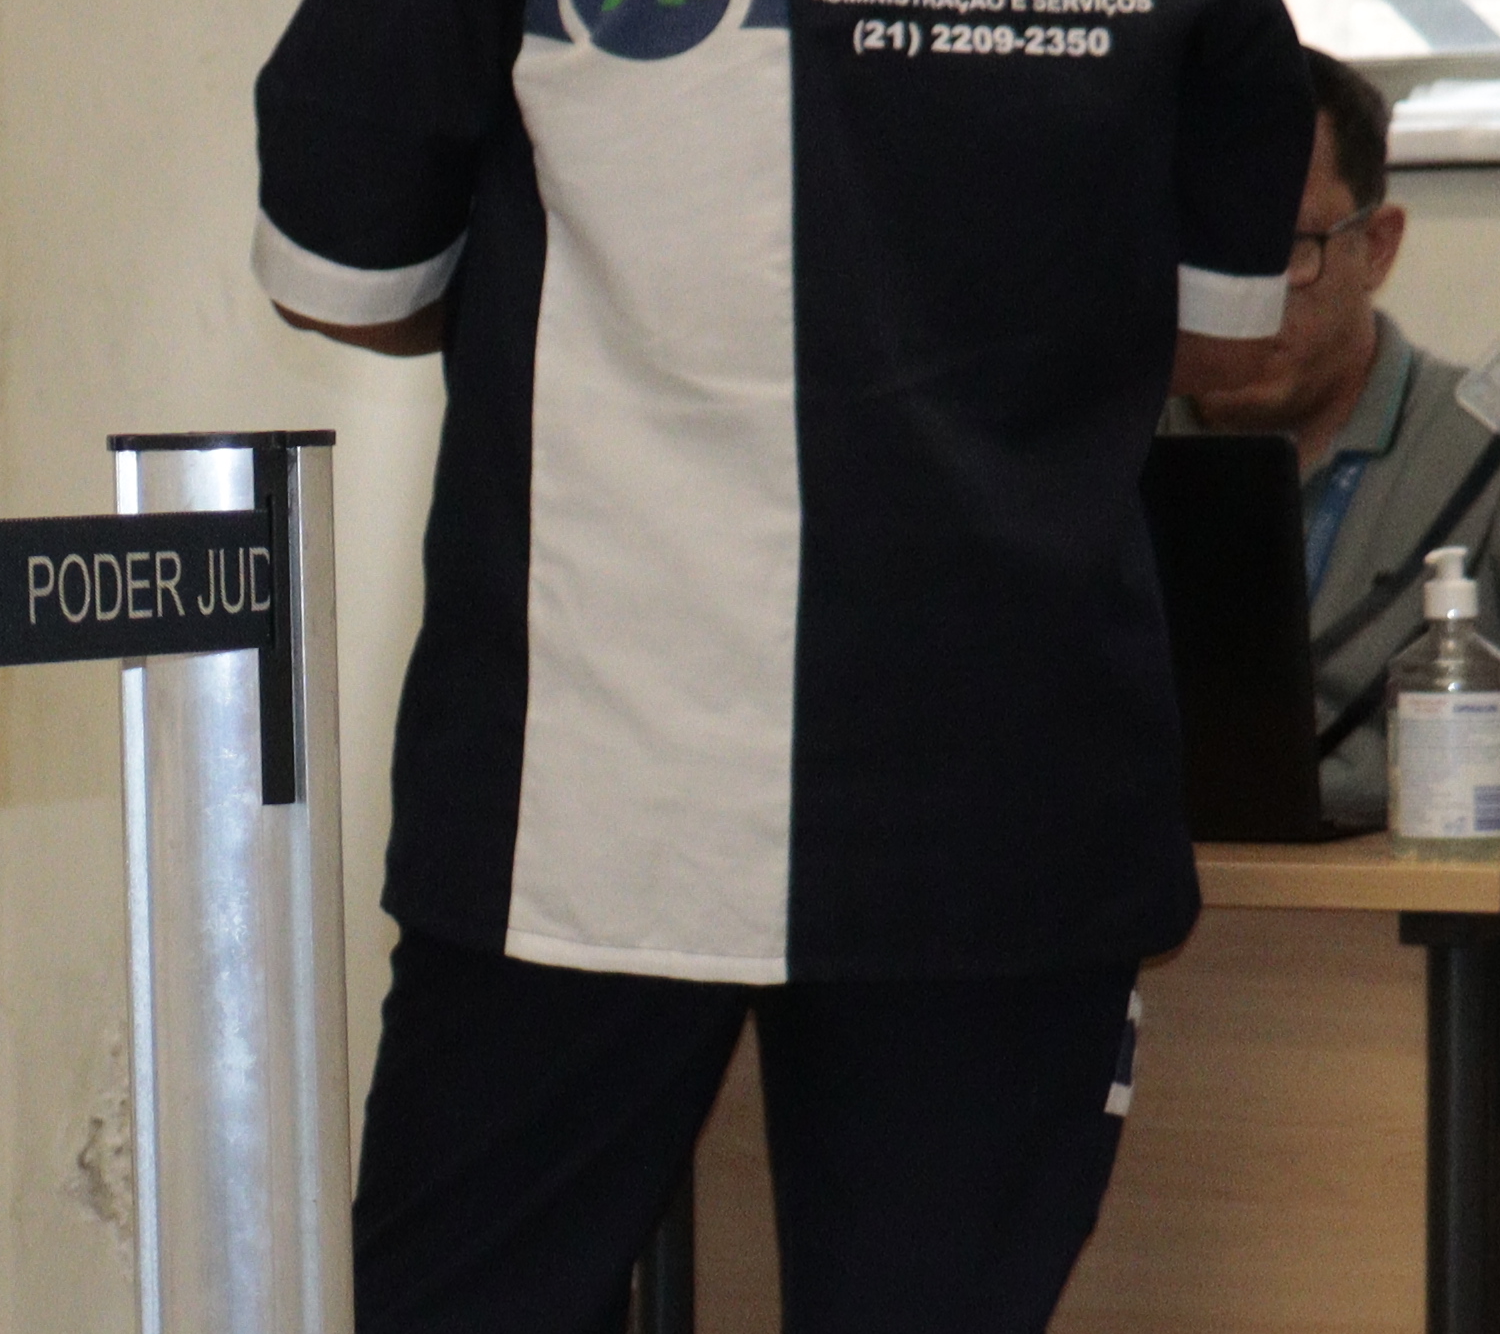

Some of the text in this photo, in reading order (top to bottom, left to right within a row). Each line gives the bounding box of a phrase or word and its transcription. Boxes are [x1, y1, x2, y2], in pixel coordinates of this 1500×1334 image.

[853, 20, 1111, 58] (21) 2209-2350
[28, 549, 185, 625] PODER
